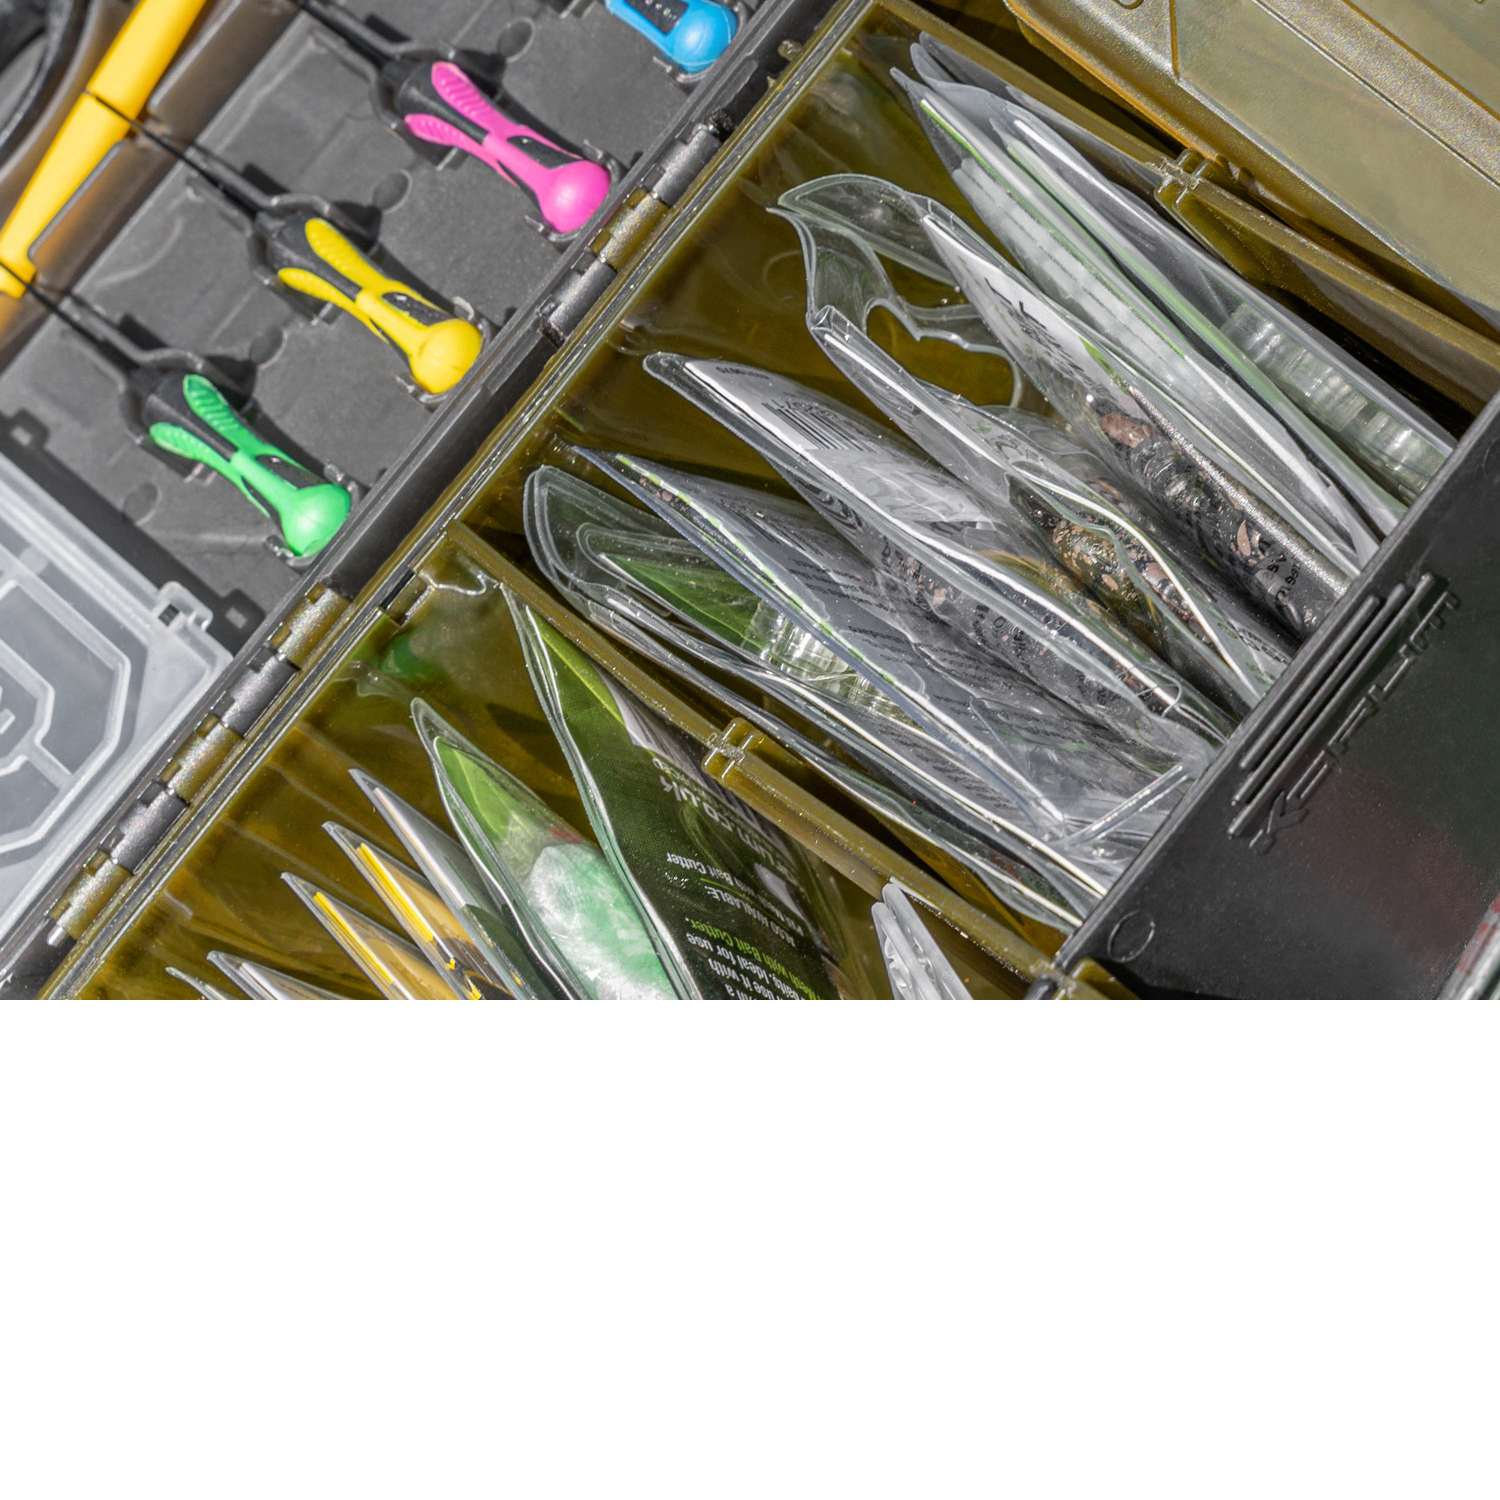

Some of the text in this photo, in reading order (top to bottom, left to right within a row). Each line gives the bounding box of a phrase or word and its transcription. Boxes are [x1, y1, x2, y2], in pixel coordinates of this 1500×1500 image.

[667, 852, 708, 875] Cutter
[706, 865, 734, 886] Bait
[686, 933, 714, 952] use
[734, 937, 763, 963] Bait
[717, 945, 737, 966] for
[709, 959, 741, 982] with
[737, 955, 770, 985] Ideal
